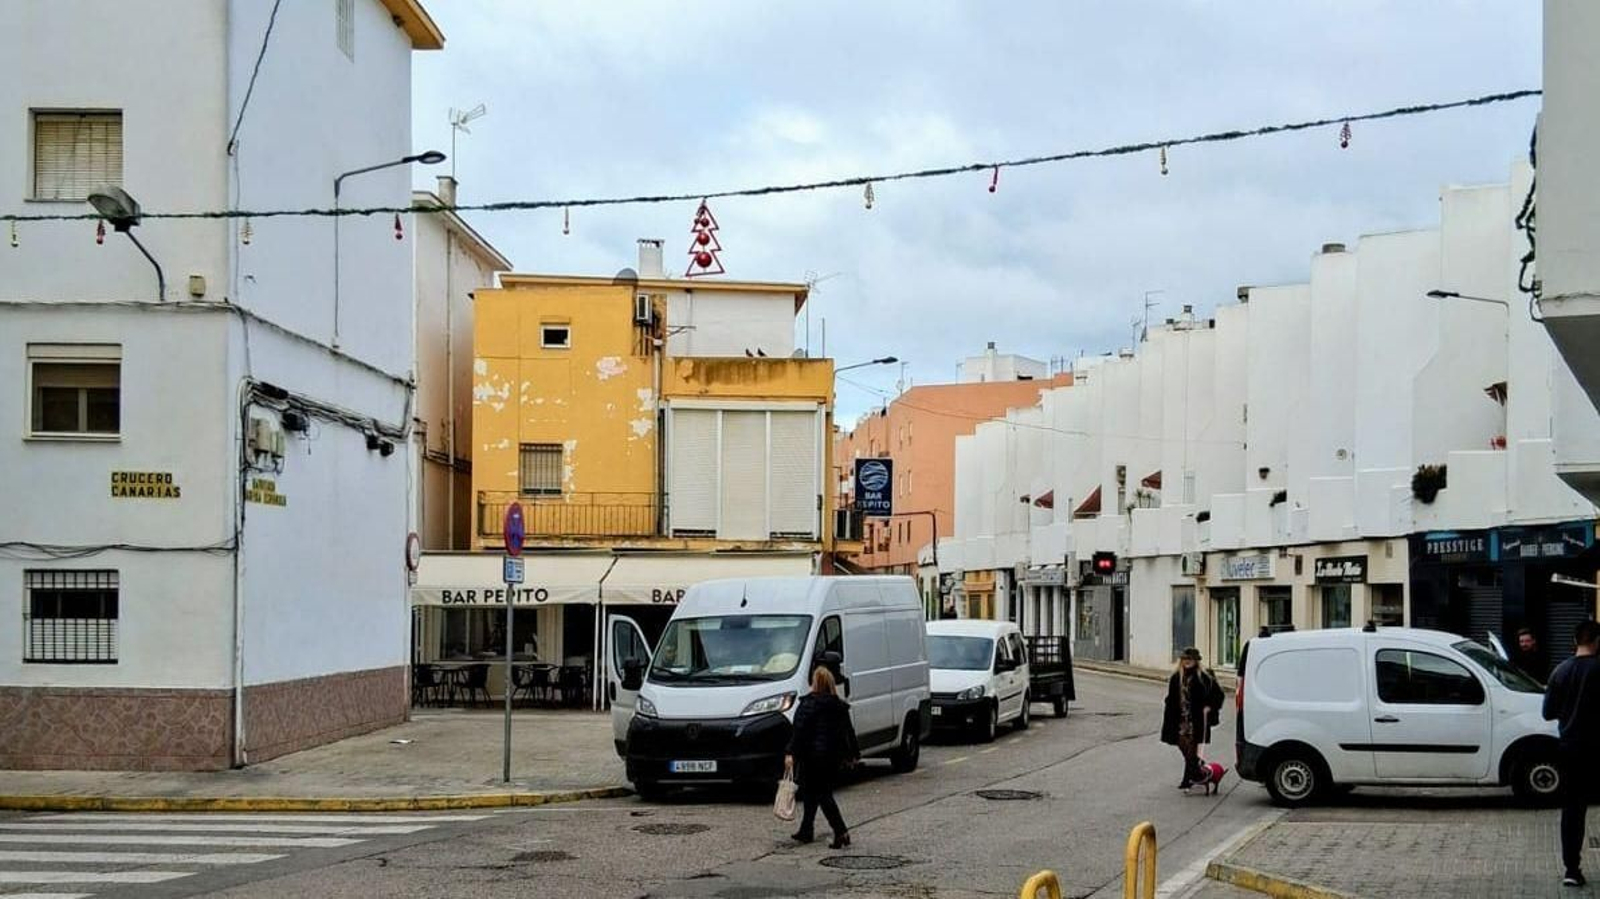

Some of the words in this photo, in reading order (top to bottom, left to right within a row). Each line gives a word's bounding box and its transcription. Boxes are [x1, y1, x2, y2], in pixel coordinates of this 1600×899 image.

[111, 472, 173, 484] CRUCERO
[111, 485, 181, 498] CANARIAS
[864, 491, 882, 500] BAR
[1427, 538, 1483, 554] PRESSTIGE
[442, 589, 477, 604] BAR
